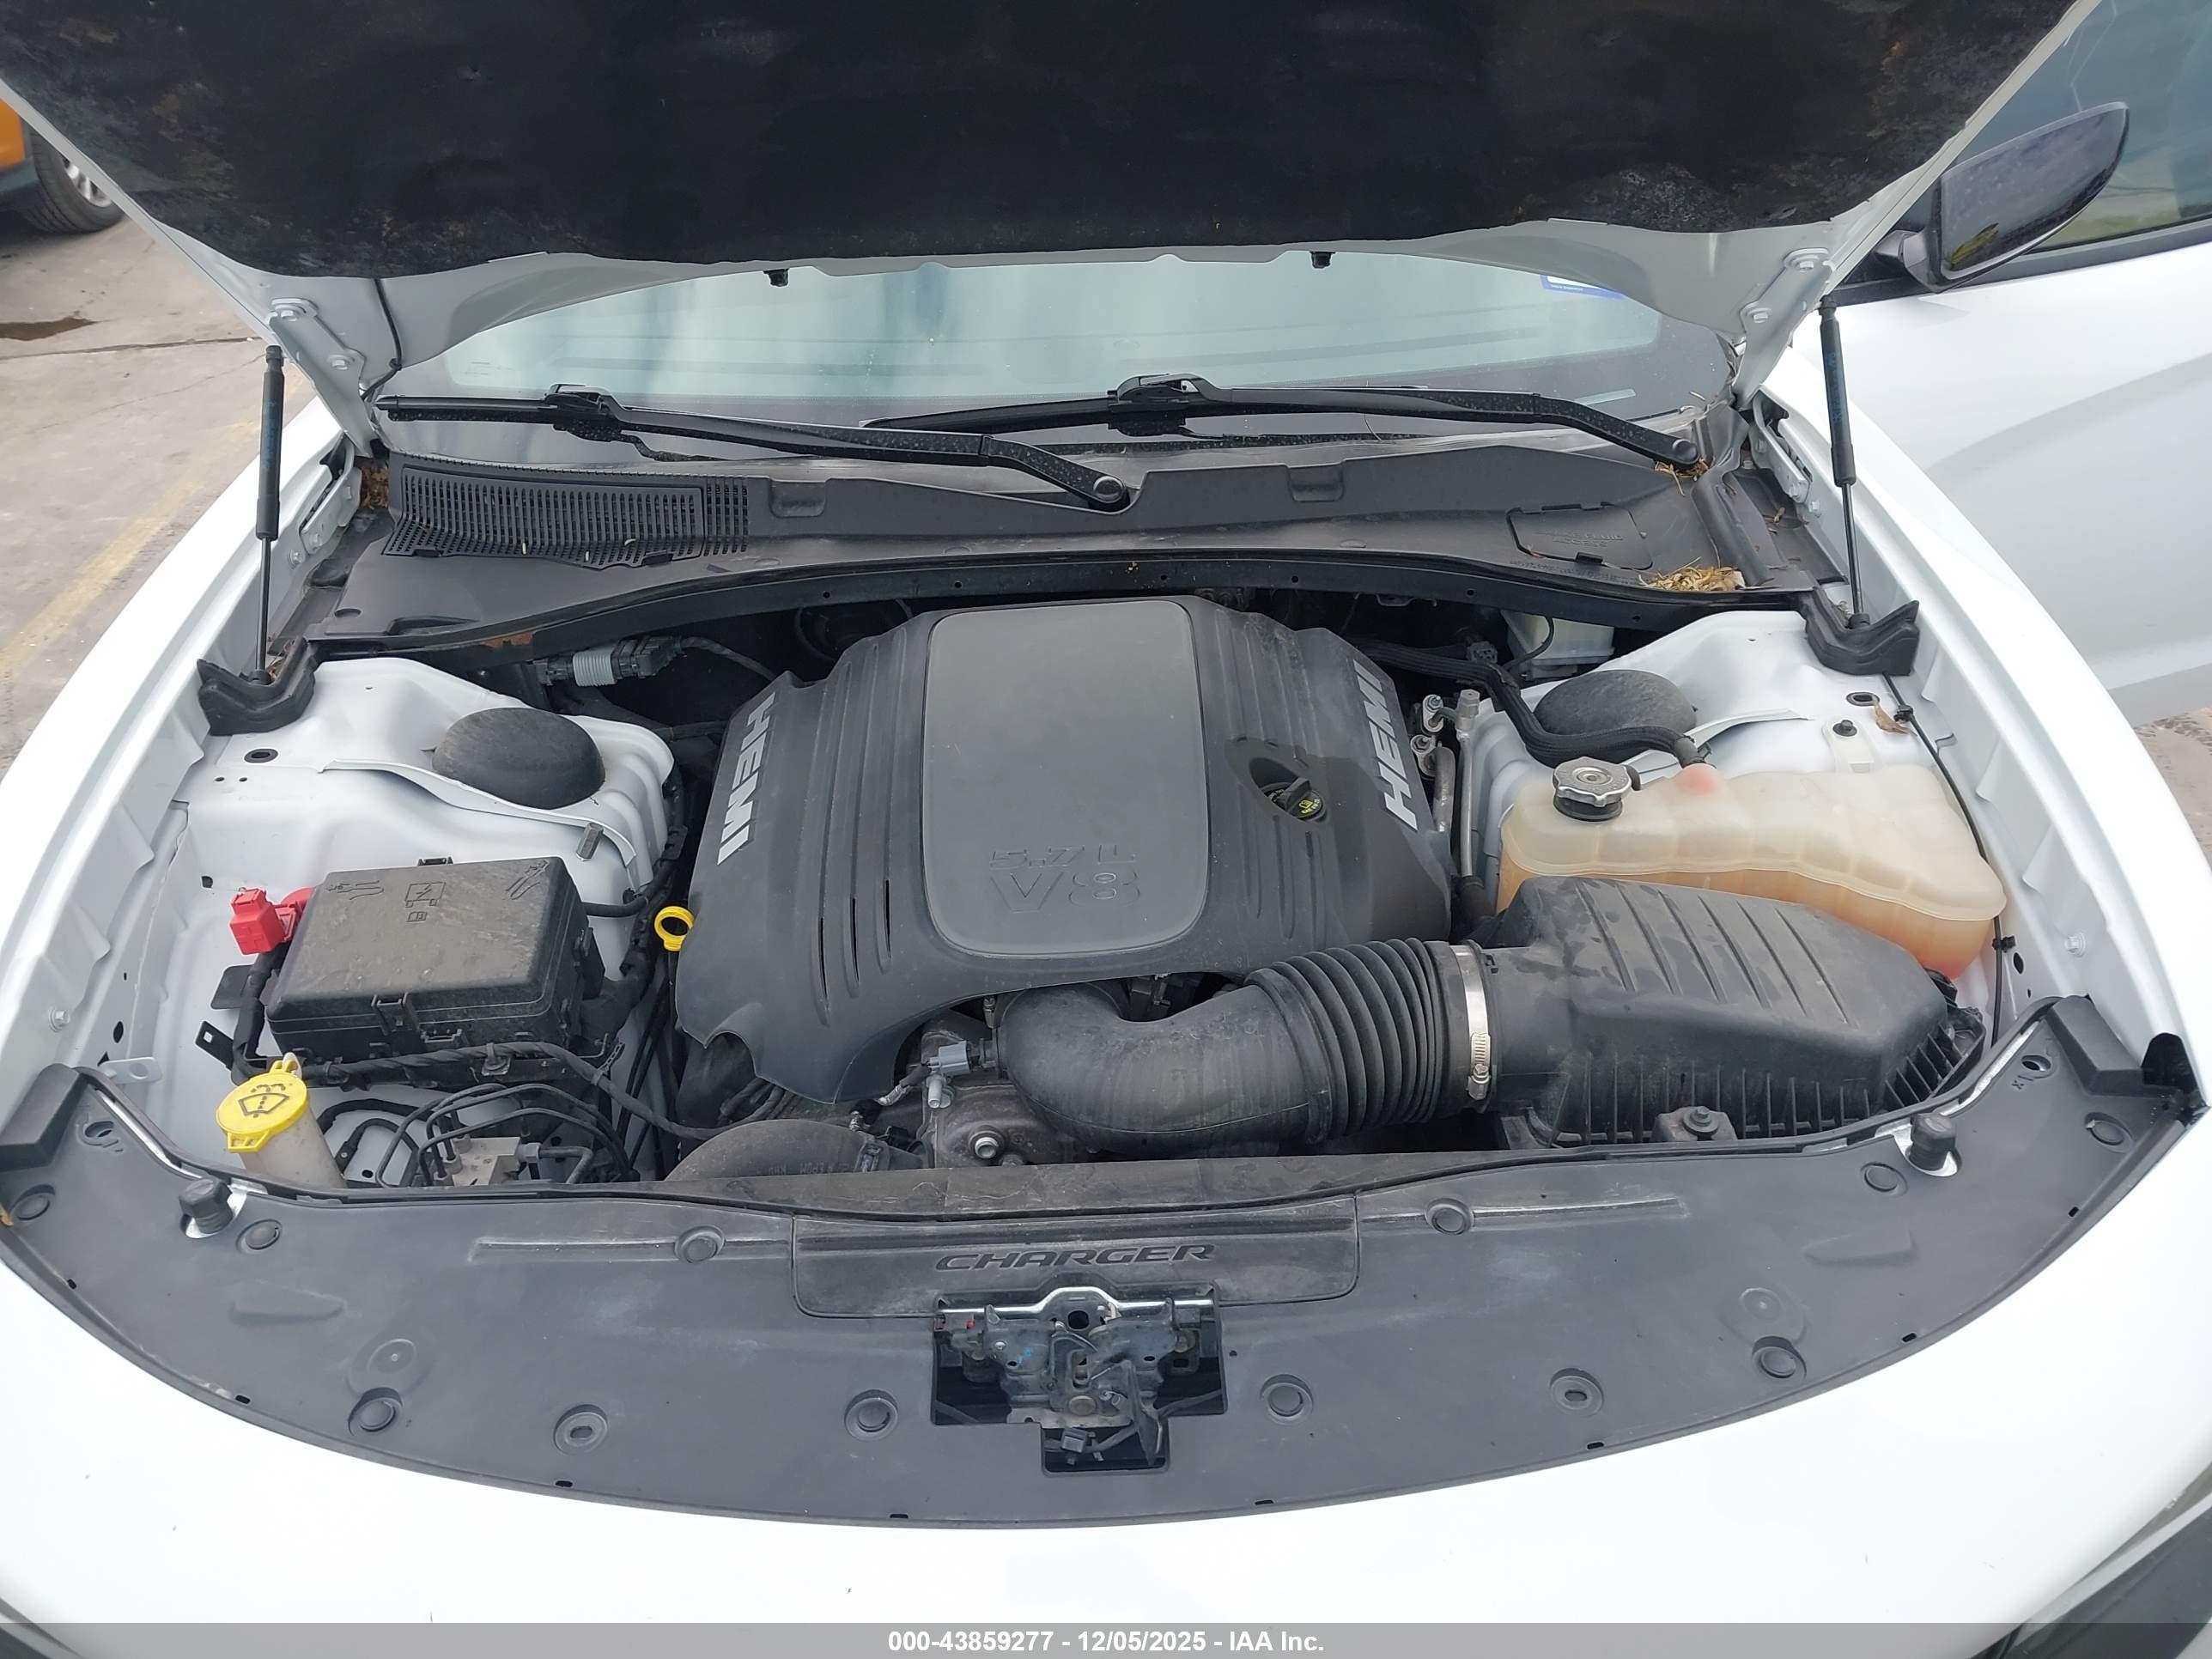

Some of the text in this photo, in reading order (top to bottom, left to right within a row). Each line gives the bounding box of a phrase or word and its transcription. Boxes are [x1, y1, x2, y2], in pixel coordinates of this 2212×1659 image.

[717, 692, 775, 866] HEMI
[1353, 659, 1418, 830] HEMI
[989, 870, 1141, 914] V8
[935, 1245, 1215, 1271] CHARGER
